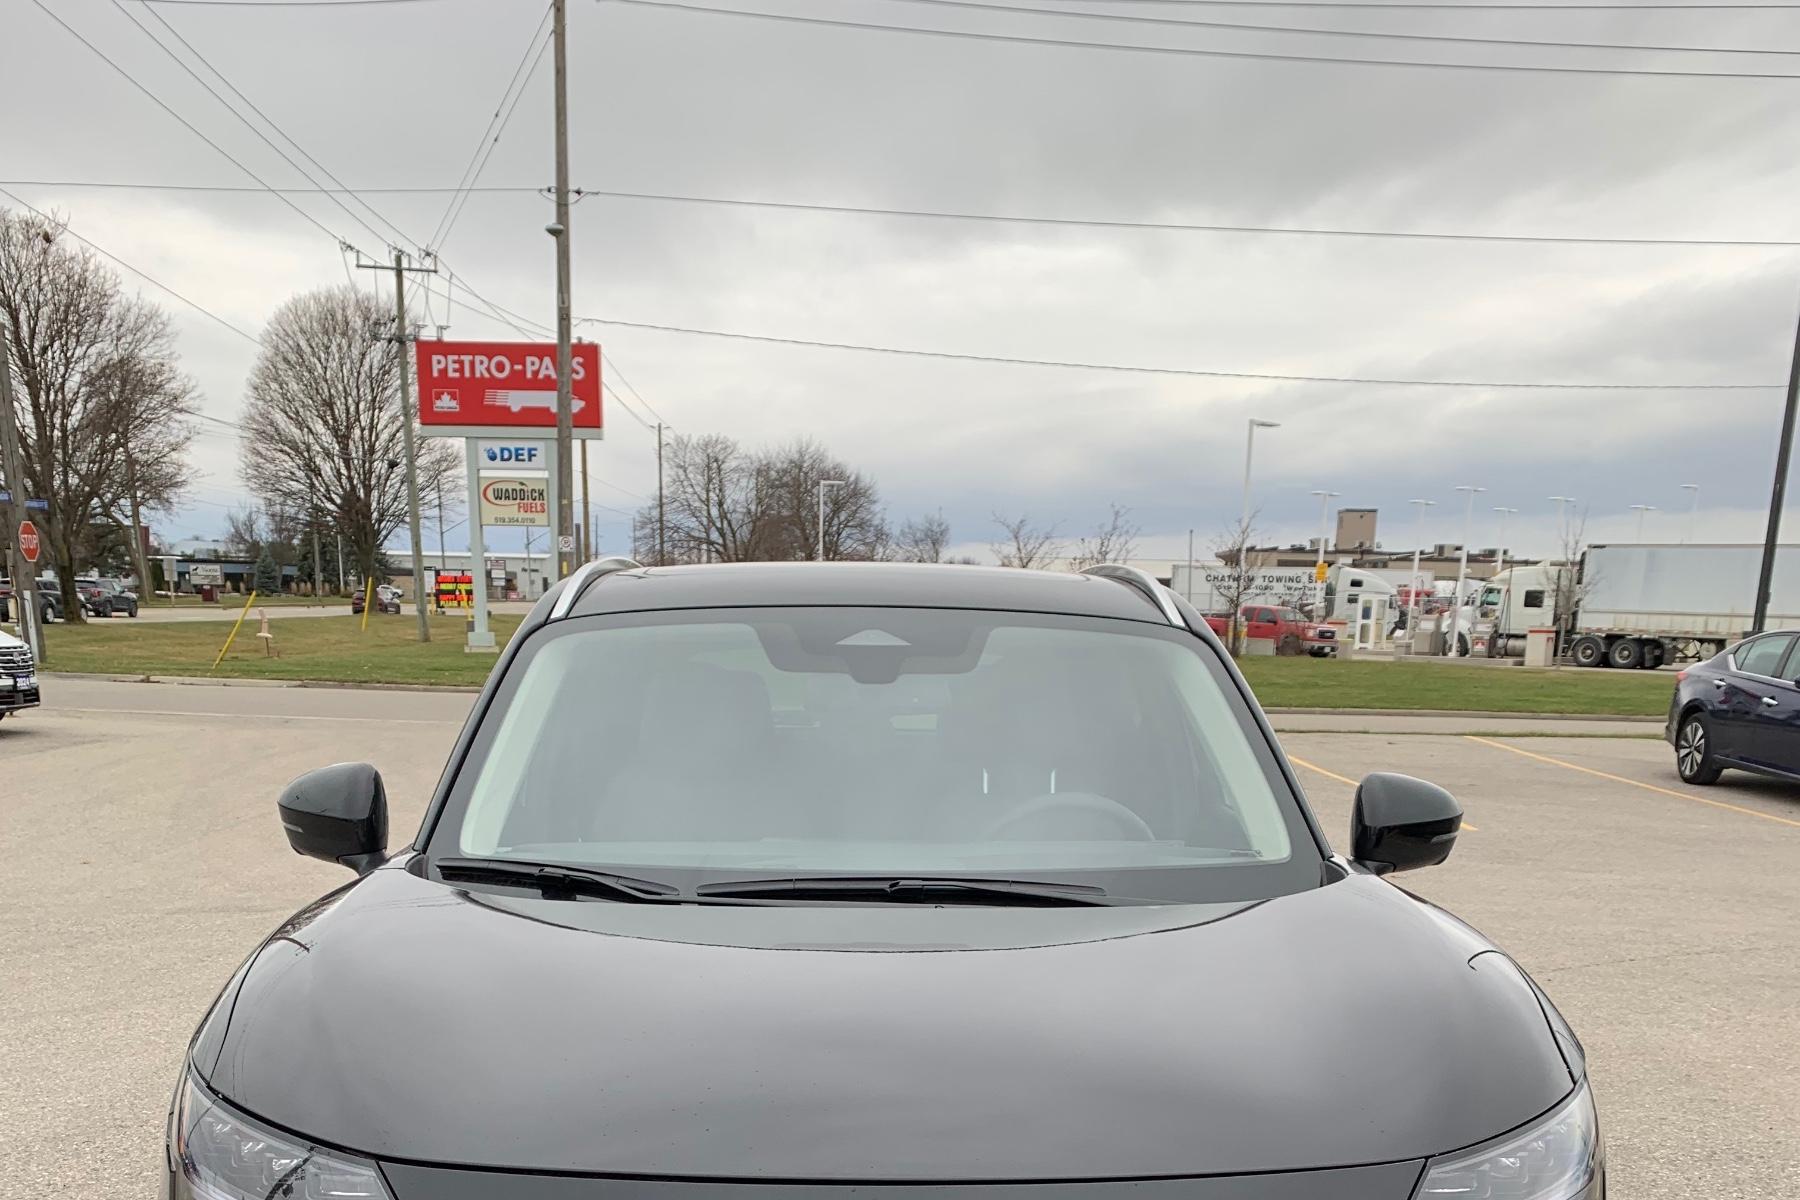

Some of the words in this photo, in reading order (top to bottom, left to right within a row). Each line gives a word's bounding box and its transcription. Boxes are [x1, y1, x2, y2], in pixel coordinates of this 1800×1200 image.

[431, 354, 585, 380] PETRO-PAS
[500, 447, 538, 462] DEF
[517, 502, 546, 513] FUELS
[21, 534, 37, 549] STOP
[1262, 575, 1302, 583] TOWING
